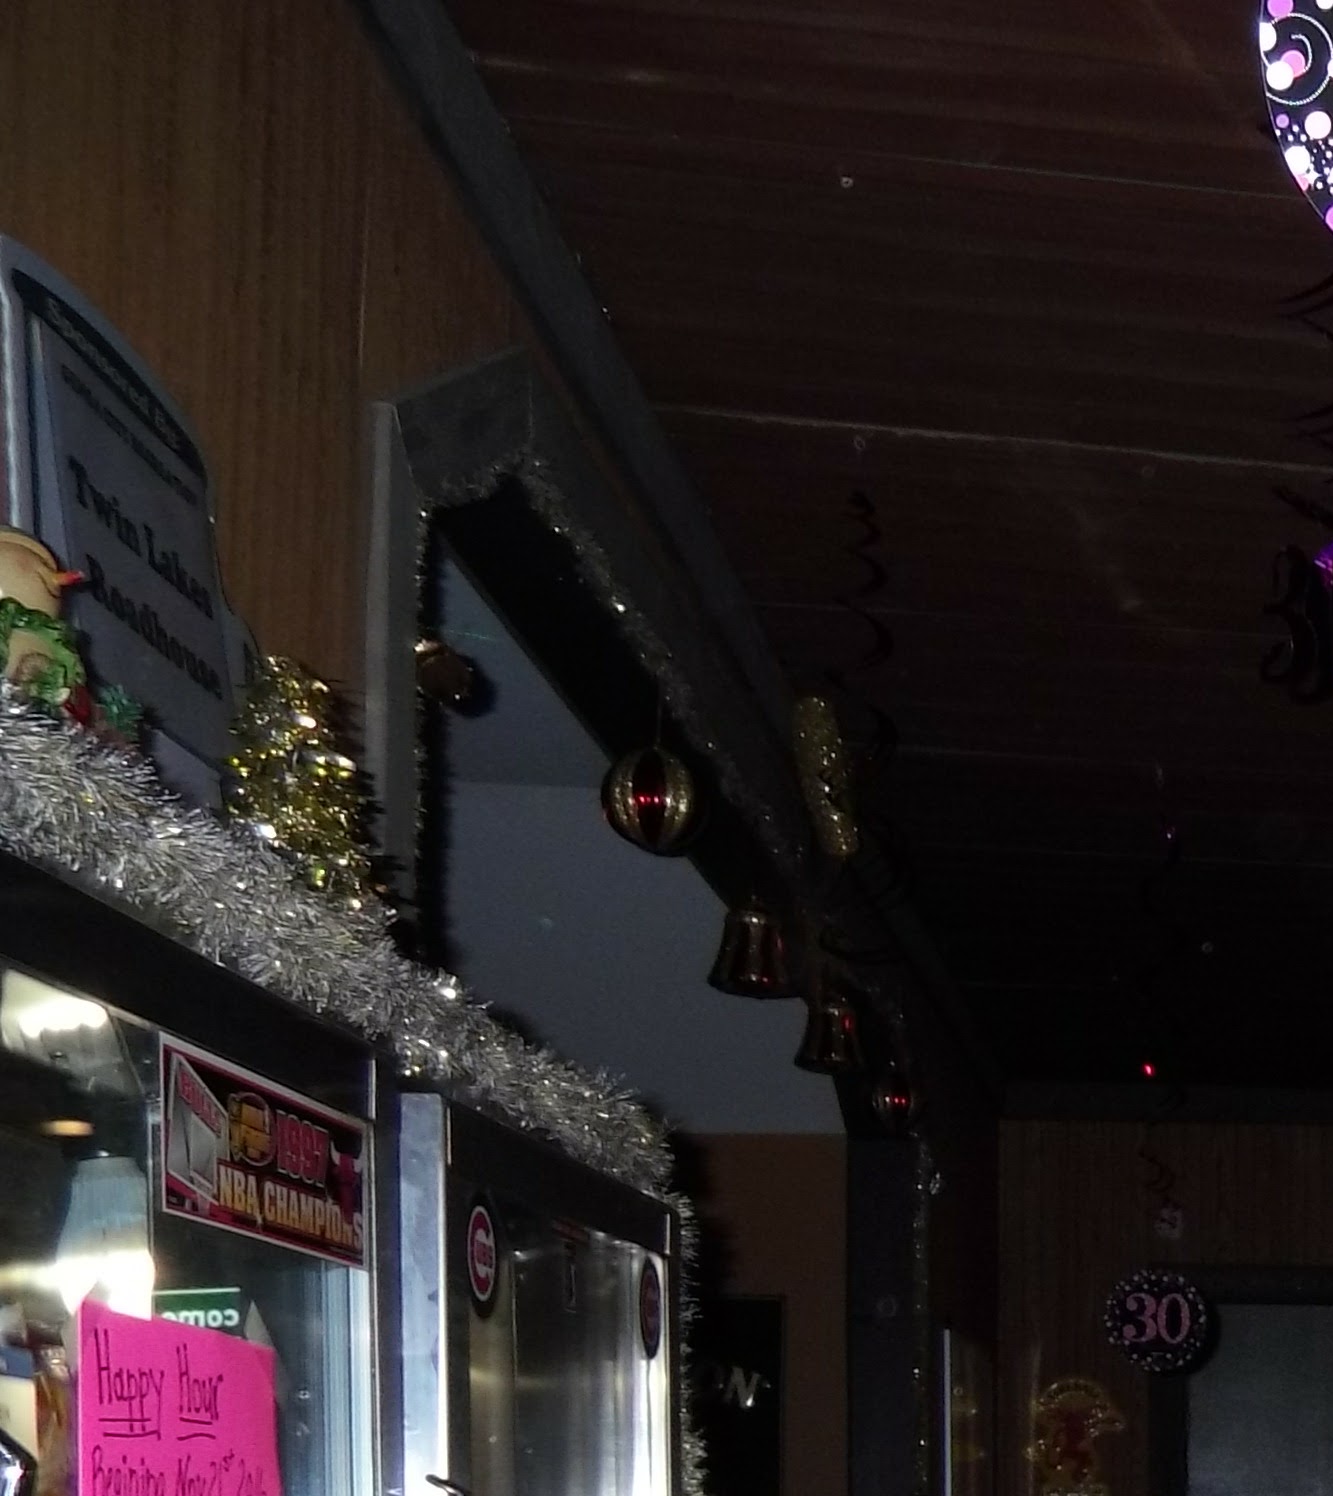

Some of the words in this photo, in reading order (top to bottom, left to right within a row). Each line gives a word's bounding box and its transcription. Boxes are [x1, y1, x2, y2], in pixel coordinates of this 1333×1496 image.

[217, 1162, 259, 1218] NBA
[263, 1180, 364, 1250] CHAMPIONS
[1122, 1292, 1191, 1344] 30
[94, 1328, 164, 1441] Happy
[177, 1343, 224, 1421] Hour
